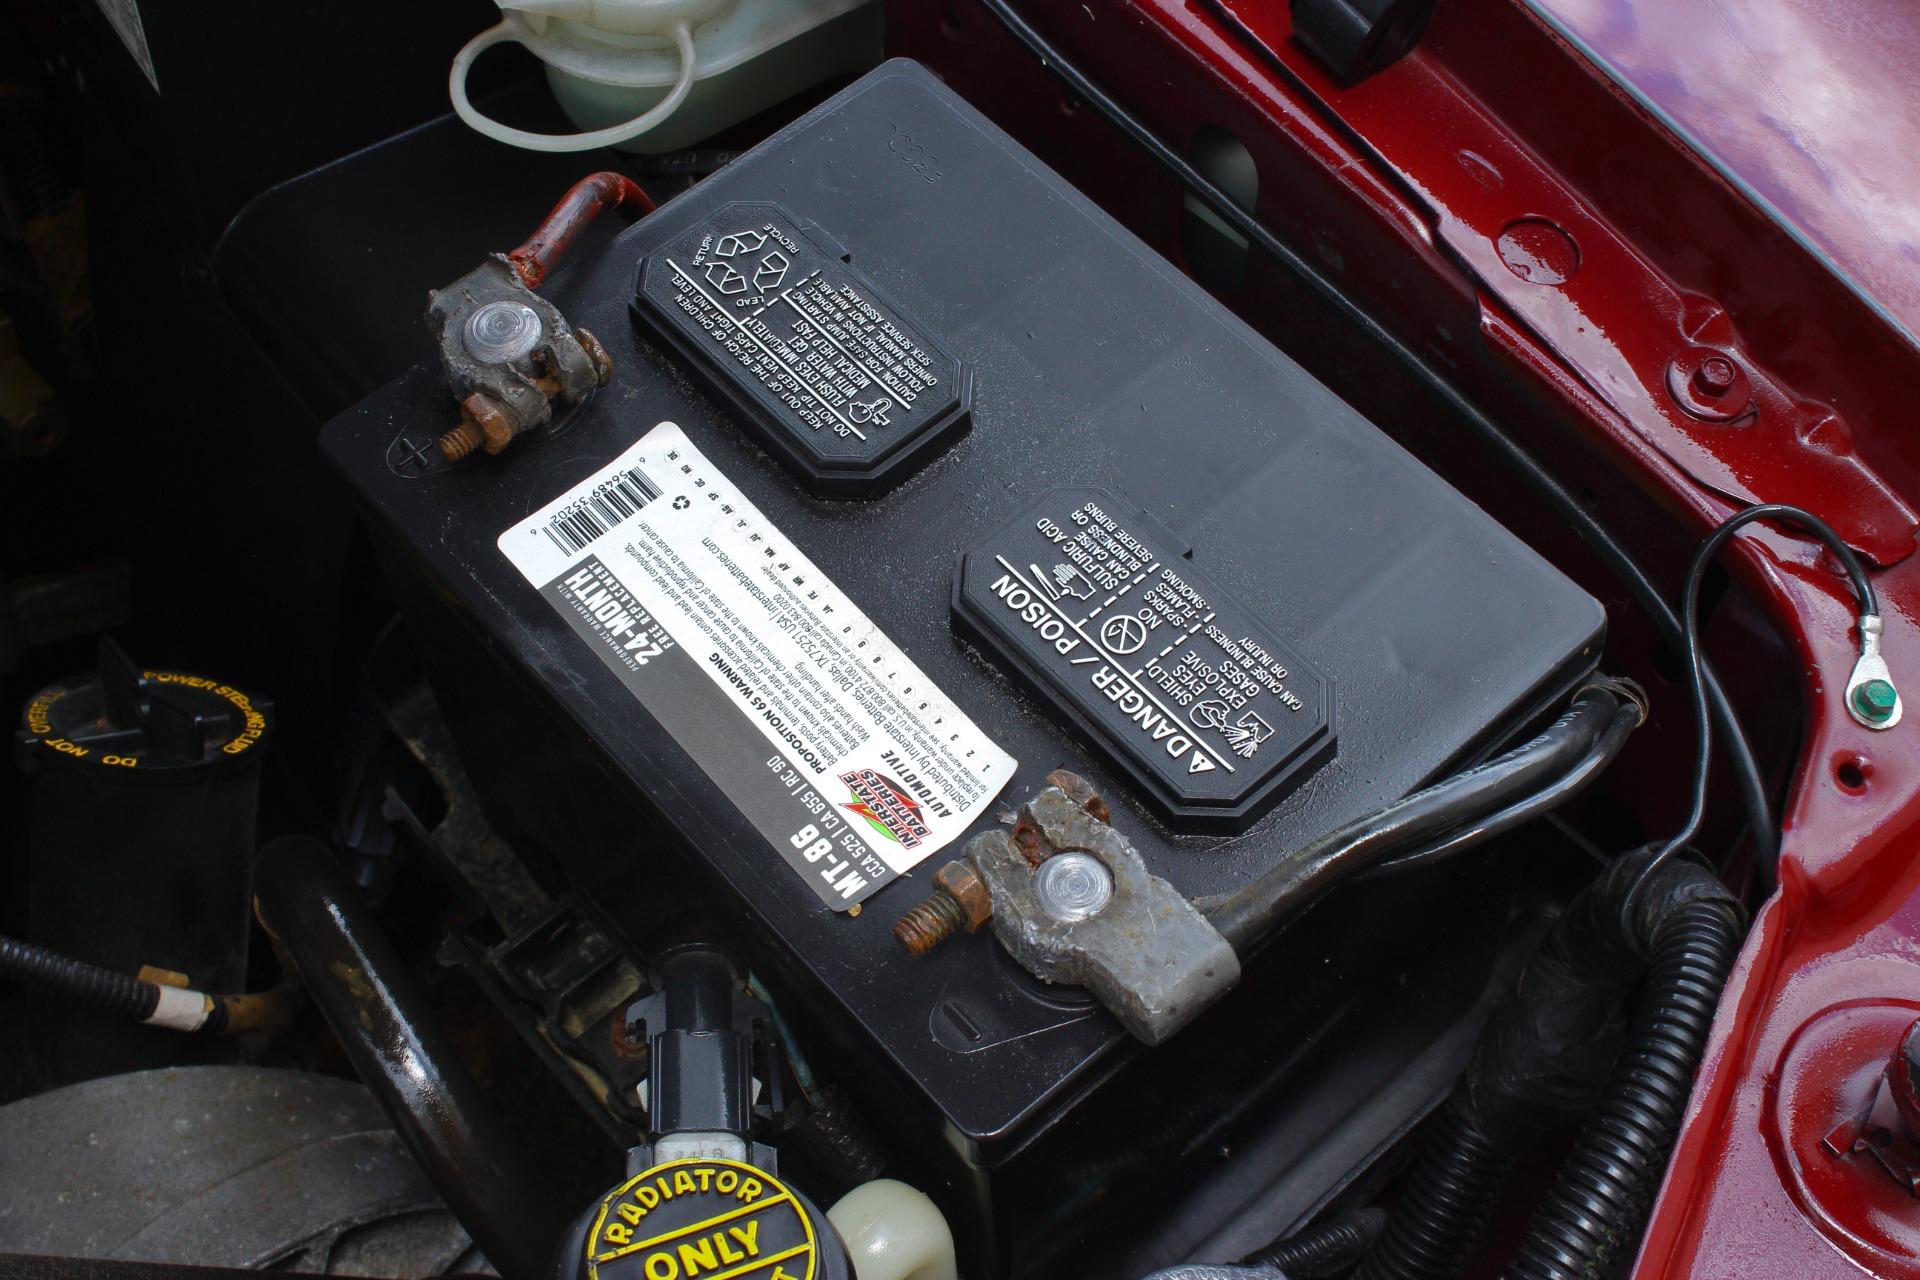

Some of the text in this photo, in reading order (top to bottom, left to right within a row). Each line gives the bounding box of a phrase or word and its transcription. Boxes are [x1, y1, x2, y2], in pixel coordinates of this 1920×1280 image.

[692, 235, 713, 266] RETURN
[763, 223, 800, 254] RECYCLE
[668, 273, 696, 296] LEVEL
[813, 277, 852, 310] AVAILABLE
[691, 294, 713, 312] AND
[736, 296, 764, 307] LEAD
[791, 290, 830, 324] STARTING
[708, 309, 737, 334] TIGHT
[848, 307, 869, 324] NOT
[863, 322, 877, 332] IF
[732, 331, 759, 354] CAPS
[786, 334, 809, 353] GET
[804, 286, 925, 392] FOLLOW INSTRUCTIONS IN VEHICLE
[825, 320, 851, 342] JUMP
[880, 320, 914, 349] SERVICE
[790, 318, 872, 389] MEDICAL HELP FAST
[845, 338, 869, 358] SAFE
[909, 347, 933, 366] SEEK
[671, 293, 824, 429] KEEP OUT OF THE REACH OF CHILDREN
[744, 316, 847, 407] FLUSH EYES IMMEDIATELY
[754, 351, 780, 373] VENT
[864, 355, 885, 372] FOR
[902, 356, 938, 387] OWNERS
[776, 370, 802, 392] KEEP
[831, 375, 859, 398] WITH
[815, 405, 837, 424] NOT
[832, 421, 851, 437] DO
[1069, 509, 1142, 571] BLINDNESS OR
[1083, 501, 1153, 562] SEVERE BURNS
[653, 538, 674, 557] cause
[668, 554, 680, 564] to
[1034, 516, 1119, 590] SULFURIC ACID
[1073, 530, 1131, 580] CAN CAUSE
[649, 552, 690, 591] reproductive
[652, 575, 670, 592] lead
[673, 560, 705, 591] California
[699, 535, 778, 616] interstatebatteries.com
[664, 587, 681, 603] and
[682, 587, 699, 603] and
[698, 585, 711, 597] of
[705, 592, 725, 610] state
[562, 566, 664, 666] 24-MONTH
[586, 559, 674, 649] FREE REPLACEMENT
[674, 598, 693, 616] lead
[694, 598, 717, 620] cancer
[718, 606, 734, 620] the
[555, 583, 640, 671] PERFORMANCE WARRANTY WITH
[687, 611, 713, 636] contain
[712, 616, 732, 635] cause
[729, 616, 740, 626] to
[774, 613, 797, 634] USA
[1135, 605, 1163, 629] NO
[726, 632, 738, 643] to
[734, 622, 759, 646] known
[790, 630, 821, 659] 75251
[707, 631, 743, 667] accessories
[732, 638, 765, 670] California
[752, 641, 786, 674] chemicals
[813, 653, 830, 668] TX
[1237, 635, 1288, 679] OR INJURY
[736, 662, 762, 687] related
[757, 665, 771, 677] of
[987, 573, 1195, 757] DANGER POISON
[1204, 623, 1304, 710] CAN CAUSE BLINDNESS
[756, 683, 774, 699] and
[765, 672, 785, 691] state
[780, 669, 802, 690] other
[1145, 664, 1194, 706] SHIELD
[1170, 663, 1208, 695] EYES
[1179, 649, 1248, 709] EXPLOSIVE
[1216, 659, 1262, 698] GASES
[778, 686, 795, 702] the
[790, 697, 801, 707] to
[795, 685, 823, 712] contain
[816, 688, 837, 707] after
[143, 671, 217, 691] POWER
[223, 729, 262, 754] FLUID
[707, 651, 827, 774] PROPOSITION 65 WARNING
[767, 695, 800, 727] terminals
[795, 704, 821, 729] known
[816, 707, 835, 724] also
[830, 702, 854, 725] hands
[814, 724, 849, 758] chemicals
[828, 719, 860, 750] Batteries
[848, 721, 871, 742] Wash
[879, 720, 921, 760] Interstate
[45, 738, 90, 757] NOT
[811, 739, 840, 766] Battery
[103, 755, 137, 768] DO
[913, 753, 933, 771] by
[879, 747, 952, 820] AUTOMOTIVE
[923, 765, 972, 813] Distributed
[841, 771, 918, 849] INTERSTATE
[859, 768, 928, 838] BATTERIES
[765, 754, 886, 878] CCA 525 CA 655 RC 90
[787, 822, 868, 899] MT-86
[604, 1168, 763, 1245] RADIATOR
[644, 1220, 760, 1280] ONLY
